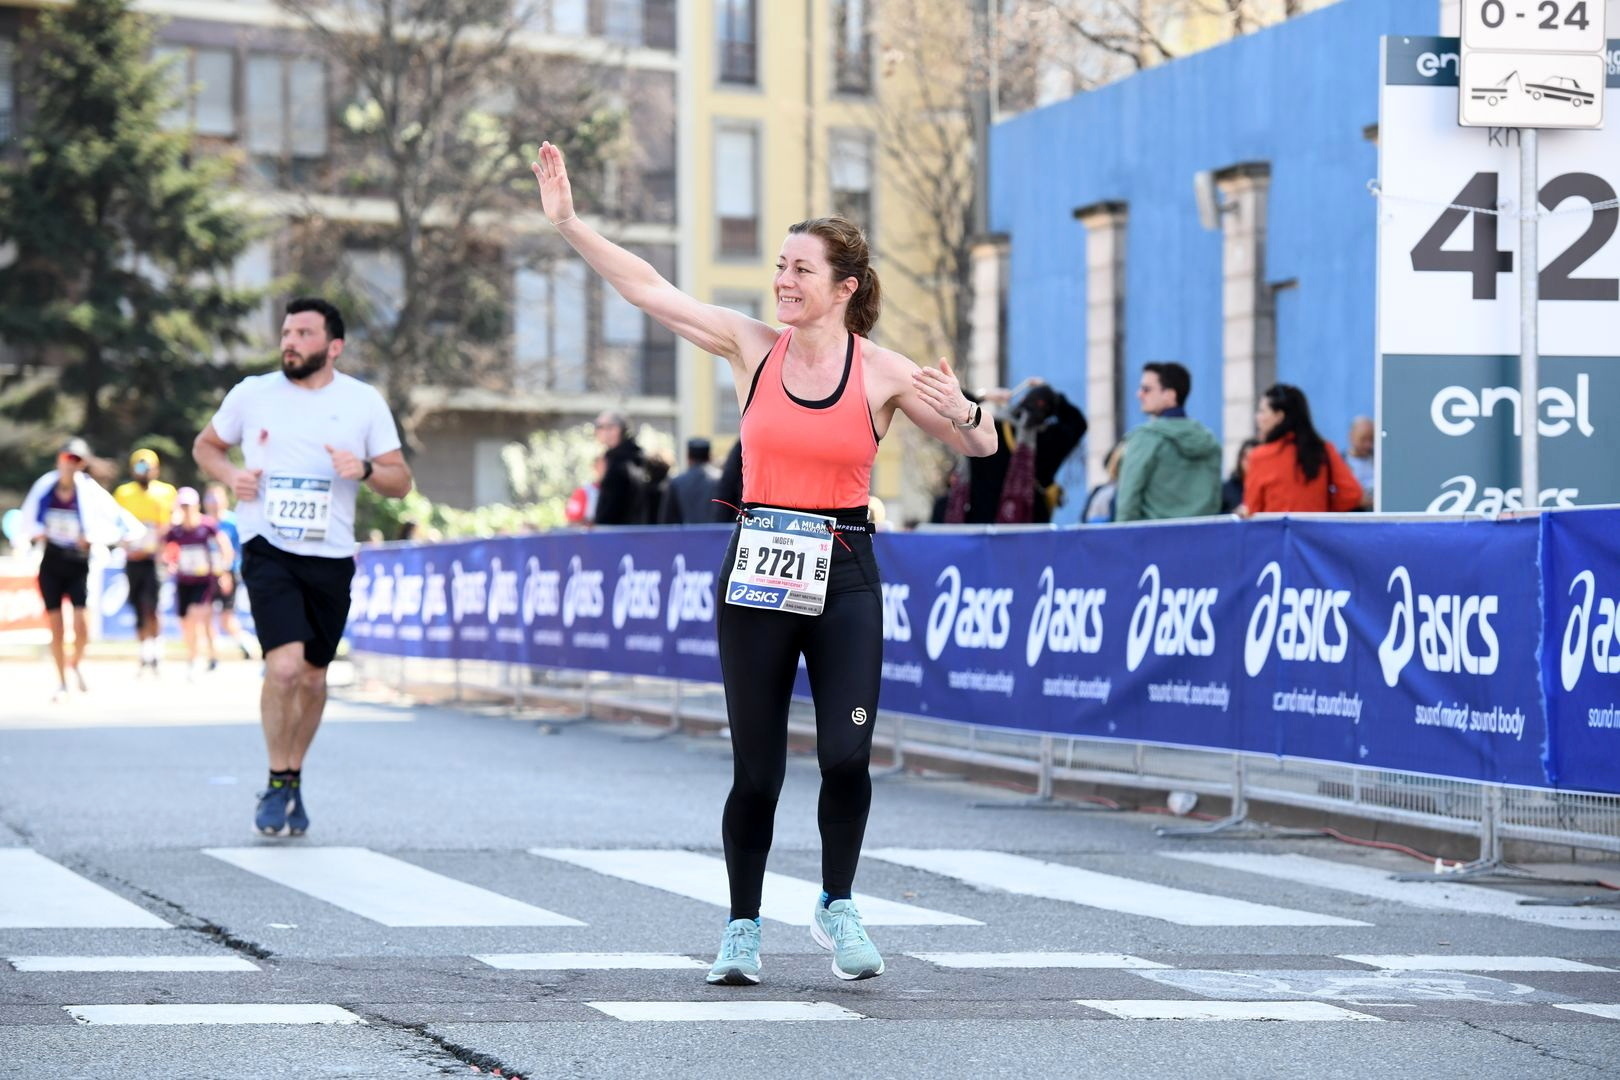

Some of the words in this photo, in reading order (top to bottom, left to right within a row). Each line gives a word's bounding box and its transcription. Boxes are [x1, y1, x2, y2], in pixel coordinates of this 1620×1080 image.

[1538, 1, 1590, 30] 24
[1410, 172, 1620, 301] 42
[1430, 373, 1595, 438] enel
[280, 500, 316, 520] 2223
[802, 520, 827, 531] MILAN
[755, 547, 805, 580] 2721
[745, 589, 779, 604] asics
[1498, 706, 1526, 741] body
[1588, 702, 1614, 729] sound
